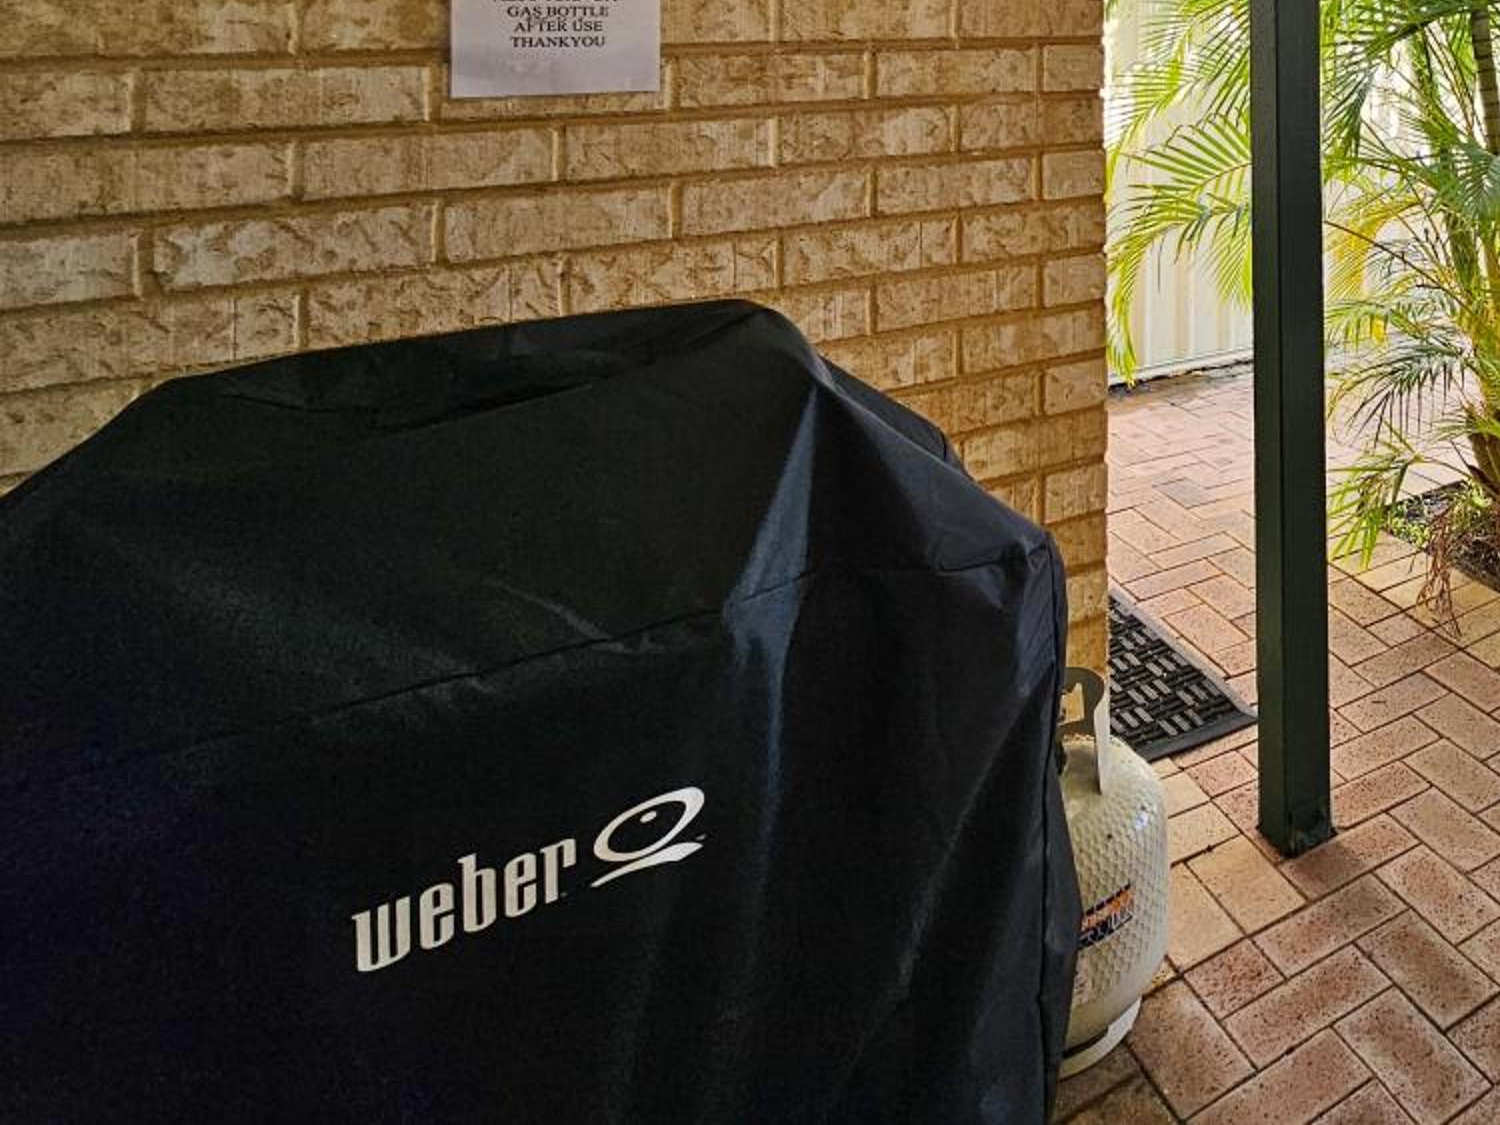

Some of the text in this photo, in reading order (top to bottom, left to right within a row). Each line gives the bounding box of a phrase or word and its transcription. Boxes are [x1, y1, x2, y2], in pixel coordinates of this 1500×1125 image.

[506, 6, 610, 17] GAS BOTTLE
[513, 20, 603, 32] AFTER USE
[510, 36, 606, 48] THANKYOU
[352, 838, 576, 972] weber
